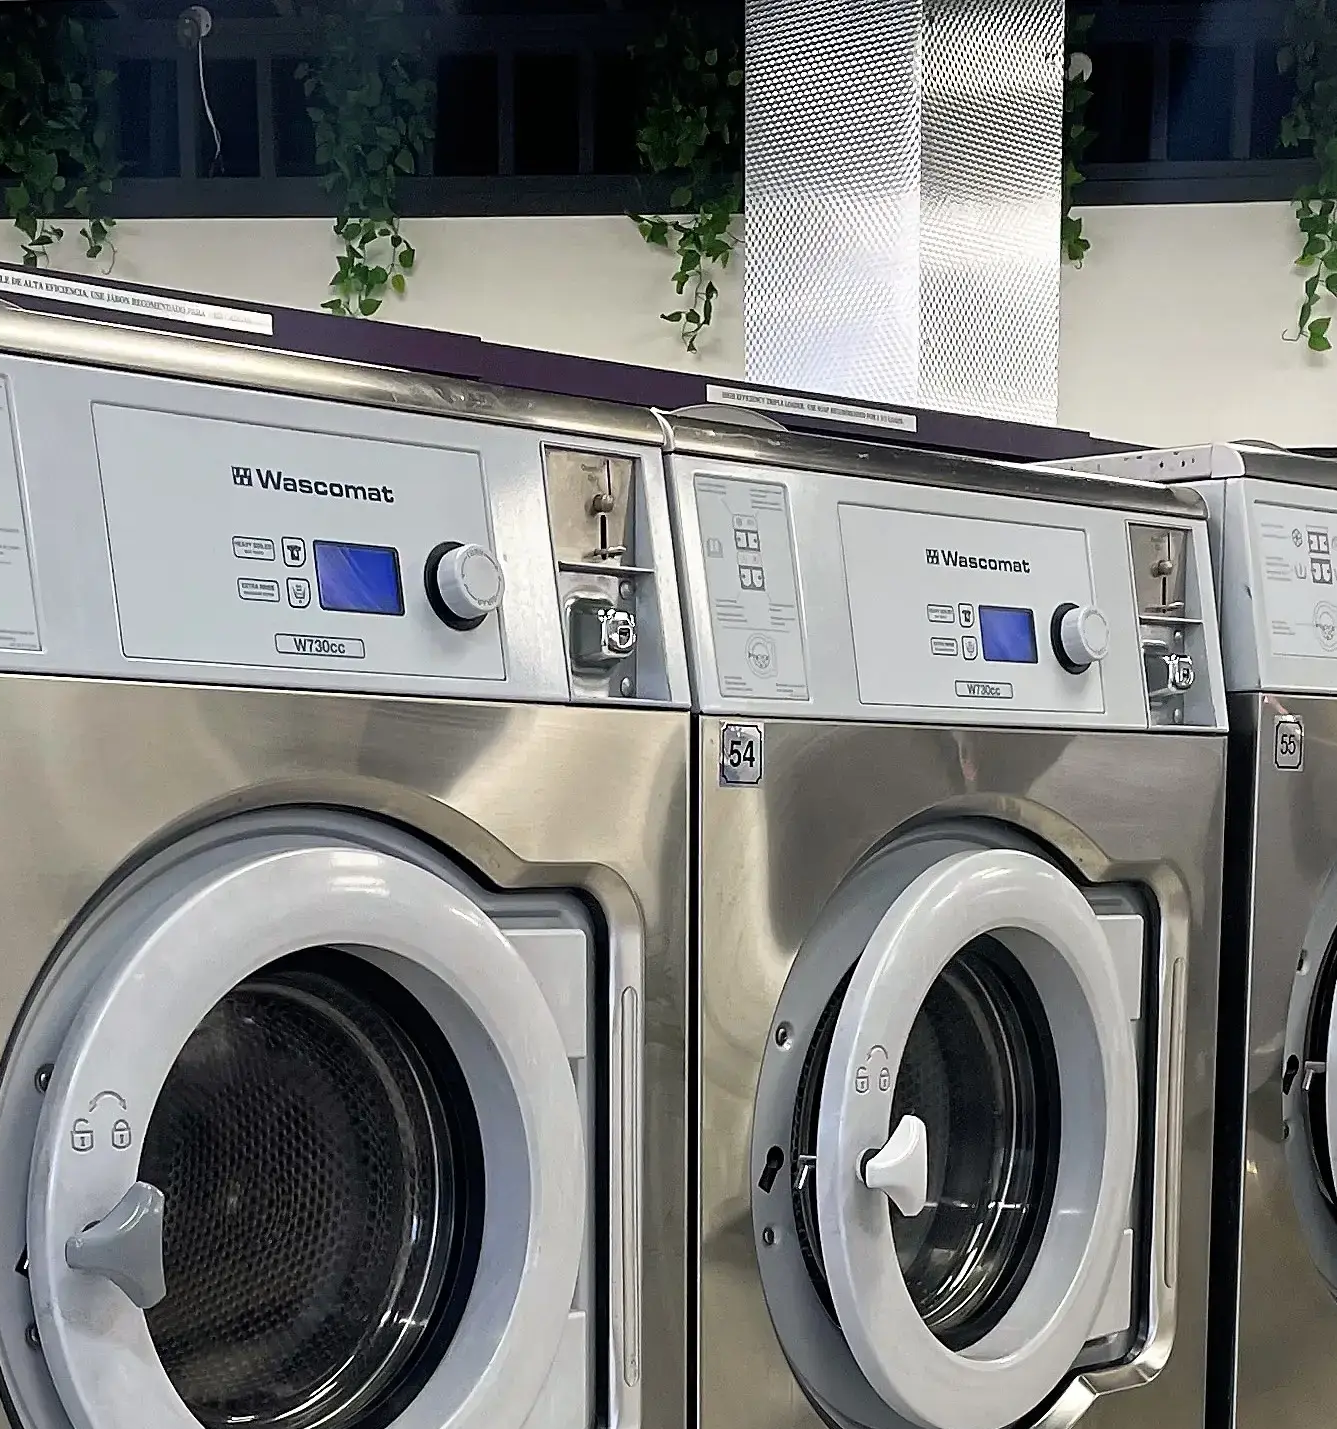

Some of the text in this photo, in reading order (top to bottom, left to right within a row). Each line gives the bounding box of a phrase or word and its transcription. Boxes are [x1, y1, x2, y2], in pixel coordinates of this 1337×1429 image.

[11, 276, 23, 287] DE
[23, 279, 44, 291] ALTA
[90, 290, 105, 301] USE
[256, 467, 396, 504] Wascomat
[940, 549, 1031, 574] Wascomat
[293, 637, 347, 655] W730cc
[966, 683, 1001, 697] W730cc
[729, 739, 756, 768] 54
[1280, 733, 1297, 755] 55
